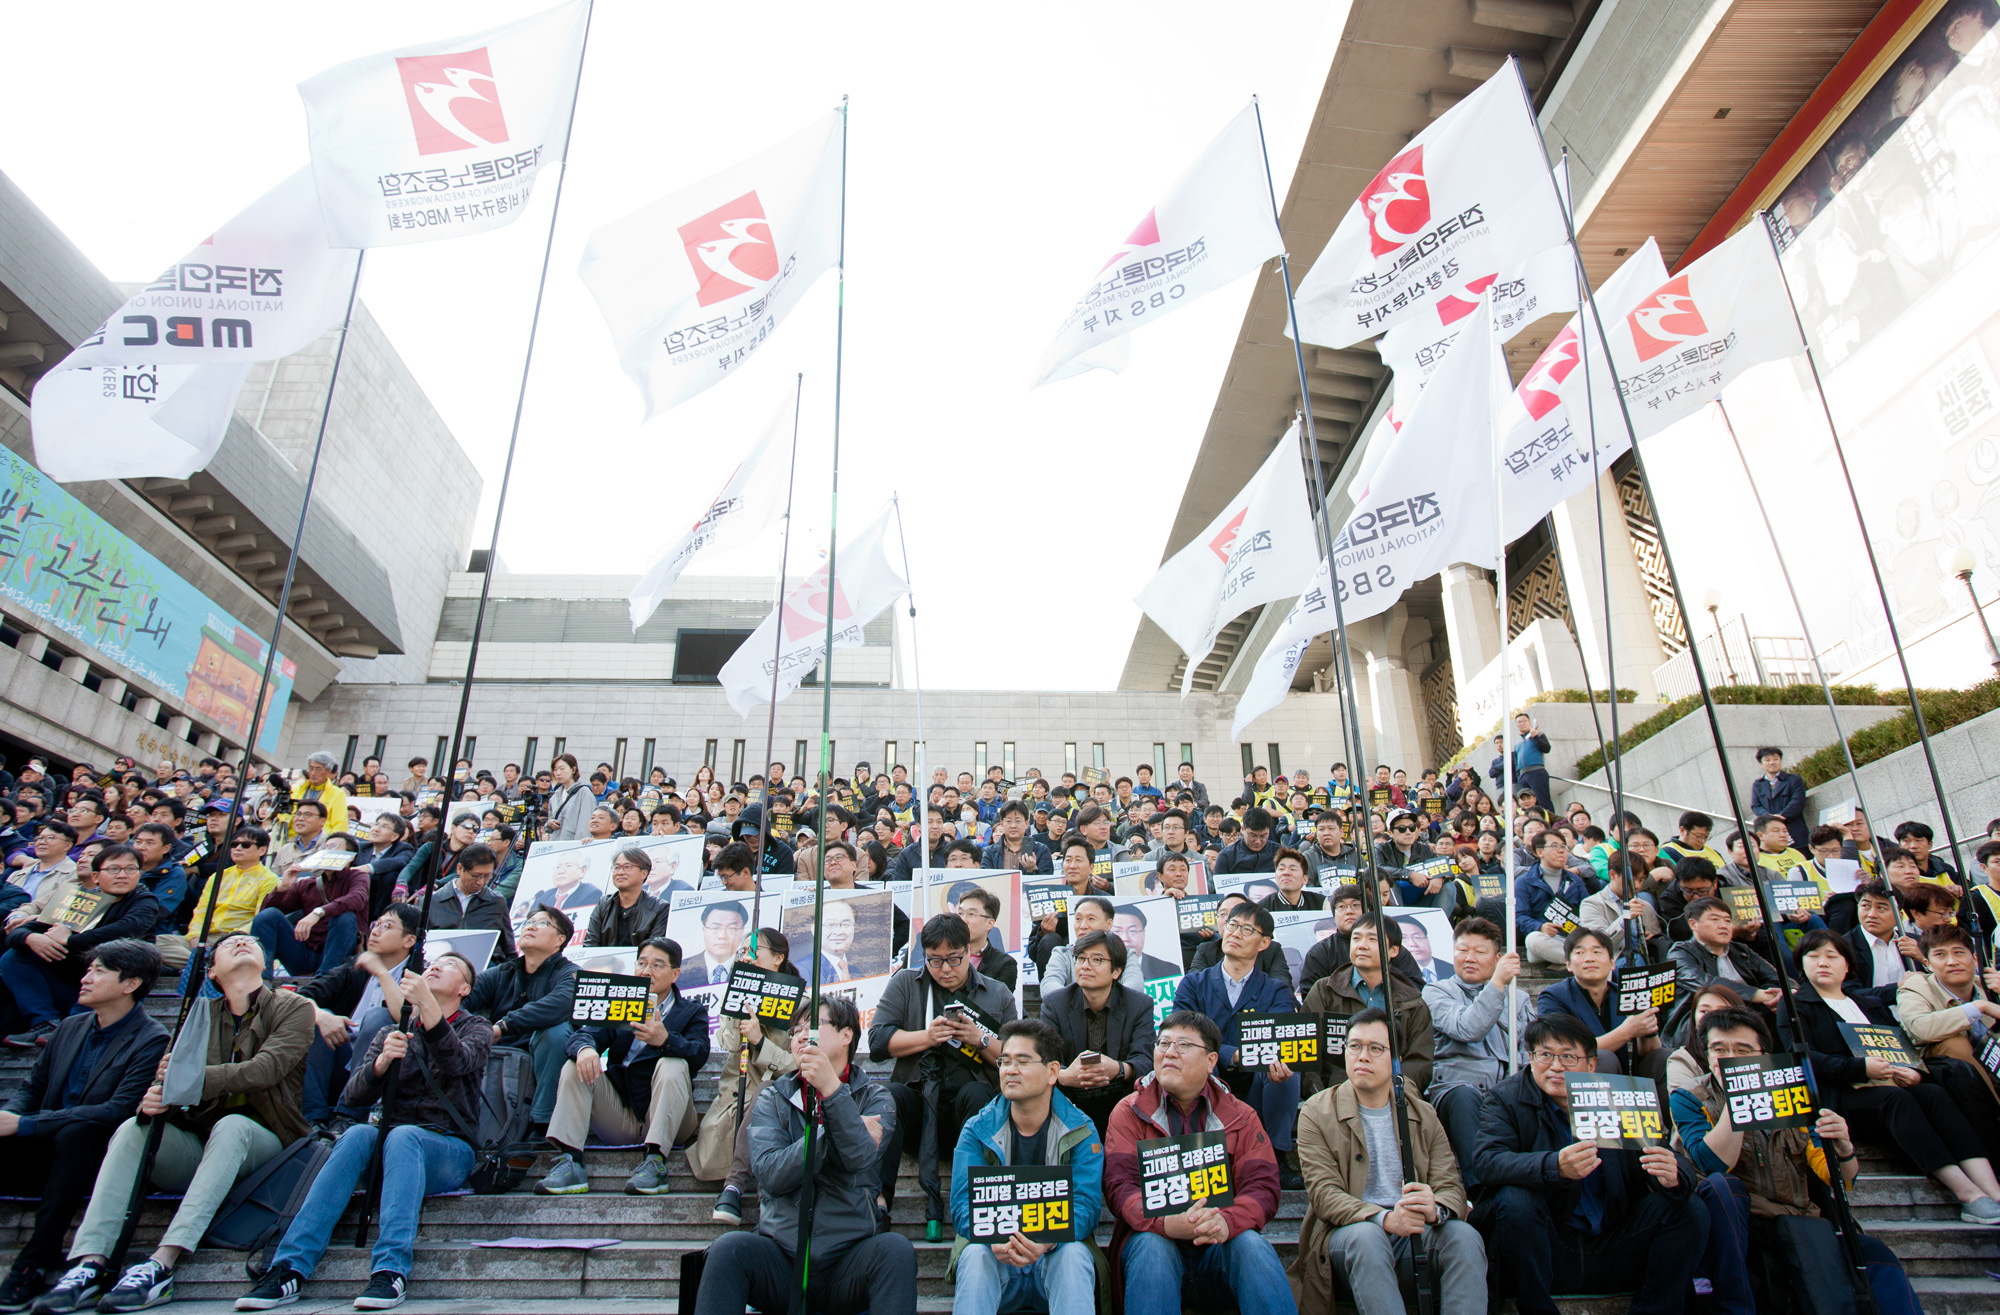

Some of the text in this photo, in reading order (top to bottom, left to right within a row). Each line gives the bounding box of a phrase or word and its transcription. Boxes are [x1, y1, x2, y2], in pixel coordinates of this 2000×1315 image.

[135, 597, 172, 650] 왜
[920, 873, 944, 883] 기화
[1092, 861, 1112, 875] 퇴진
[61, 895, 98, 914] 세상을
[678, 896, 702, 907] 김도인
[1030, 899, 1068, 917] 당장퇴
[1774, 896, 1822, 911] 당장퇴진
[51, 907, 89, 926] 밝히자
[1180, 912, 1218, 930] 당장퇴
[1543, 906, 1578, 934] 당장퇴
[730, 976, 799, 998] 고대영 김장겸은
[1620, 977, 1647, 991] 고대영
[1648, 969, 1676, 987] 김장겸은
[576, 984, 647, 999] 고대영 김장겸은
[1619, 982, 1675, 1012] 당장퇴진
[572, 999, 645, 1022] 당장퇴진
[724, 990, 795, 1020] 당장퇴진
[1240, 1022, 1317, 1041] 고대영 김장겸은
[1327, 1024, 1347, 1035] 고대
[1241, 1038, 1318, 1066] 당장퇴진
[1859, 1034, 1902, 1049] 세상을
[1725, 1066, 1806, 1092] 고대영 김장겸은
[1571, 1091, 1657, 1107] 고대영 김장겸은
[1729, 1085, 1812, 1124] 당장퇴진
[1574, 1111, 1662, 1139] 당장퇴진
[1143, 1144, 1225, 1177] 고대영 김장겸은
[972, 1179, 1069, 1203] 고대영 김장겸은
[1144, 1163, 1229, 1210] 당장퇴진
[973, 1200, 1069, 1236] 당장퇴진
